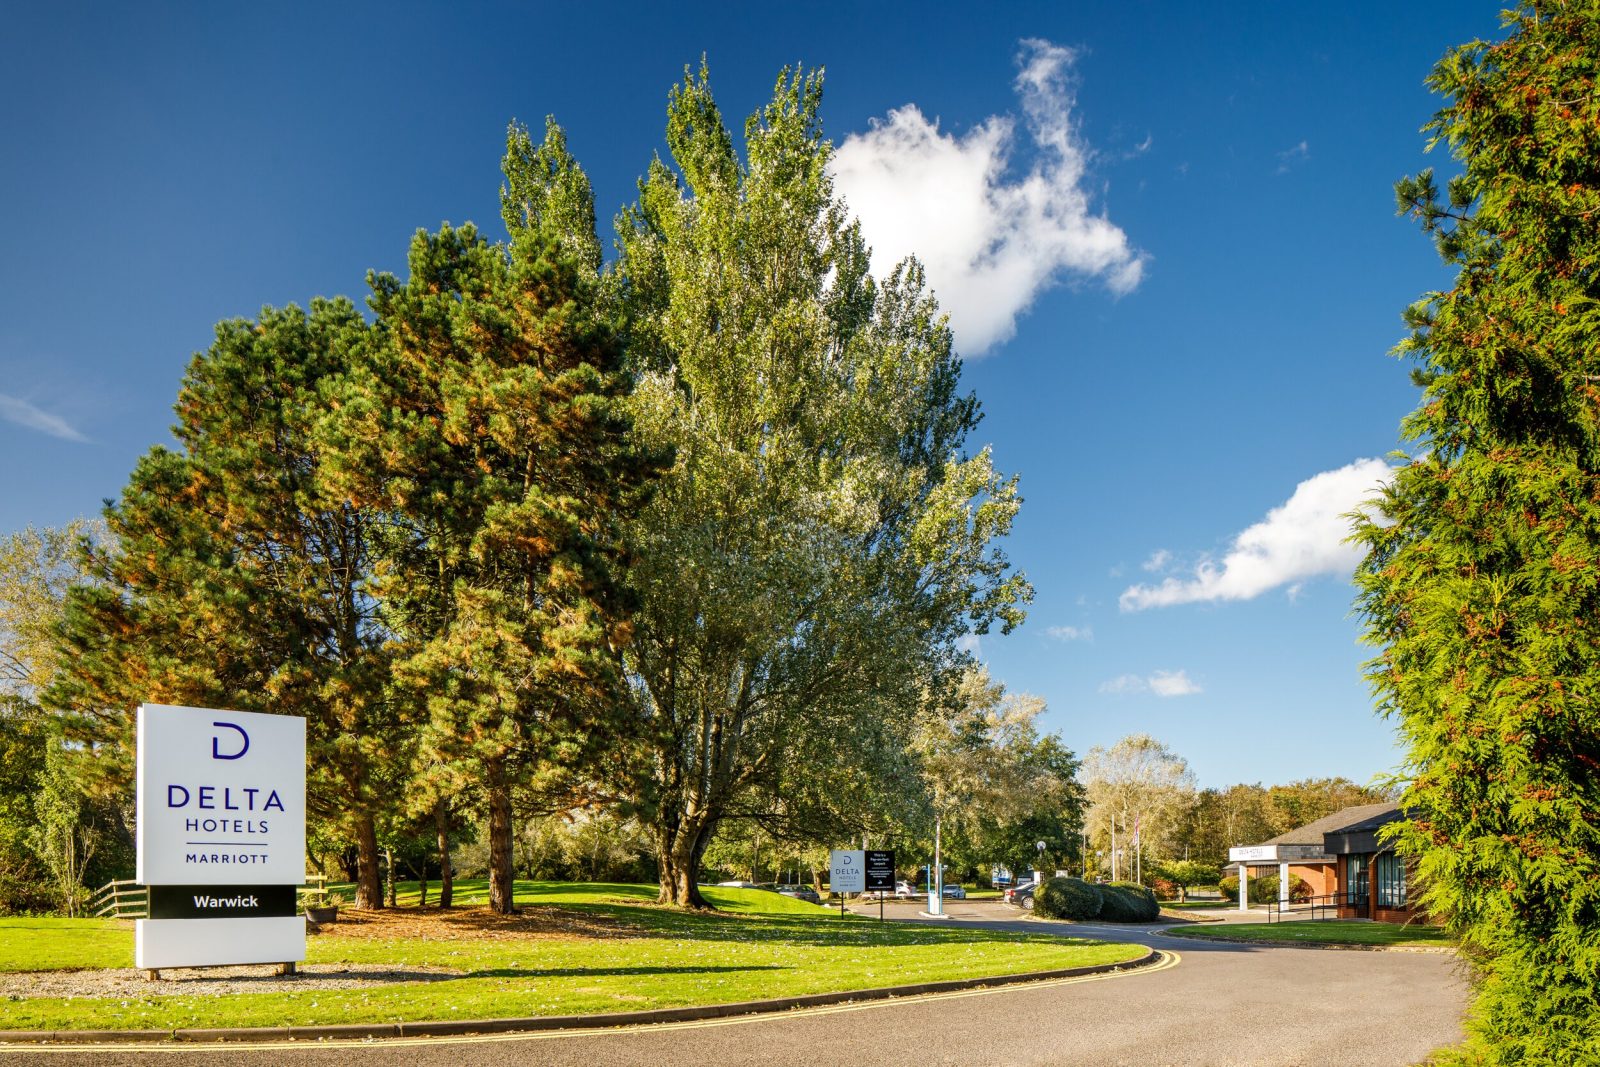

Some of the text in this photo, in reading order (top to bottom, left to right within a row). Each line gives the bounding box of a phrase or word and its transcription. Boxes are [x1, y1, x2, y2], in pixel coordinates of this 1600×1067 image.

[212, 721, 250, 760] D
[167, 784, 285, 812] DELTA
[186, 818, 269, 834] HOTELS
[186, 853, 269, 864] MARRIOTT
[193, 895, 259, 908] Warwick
